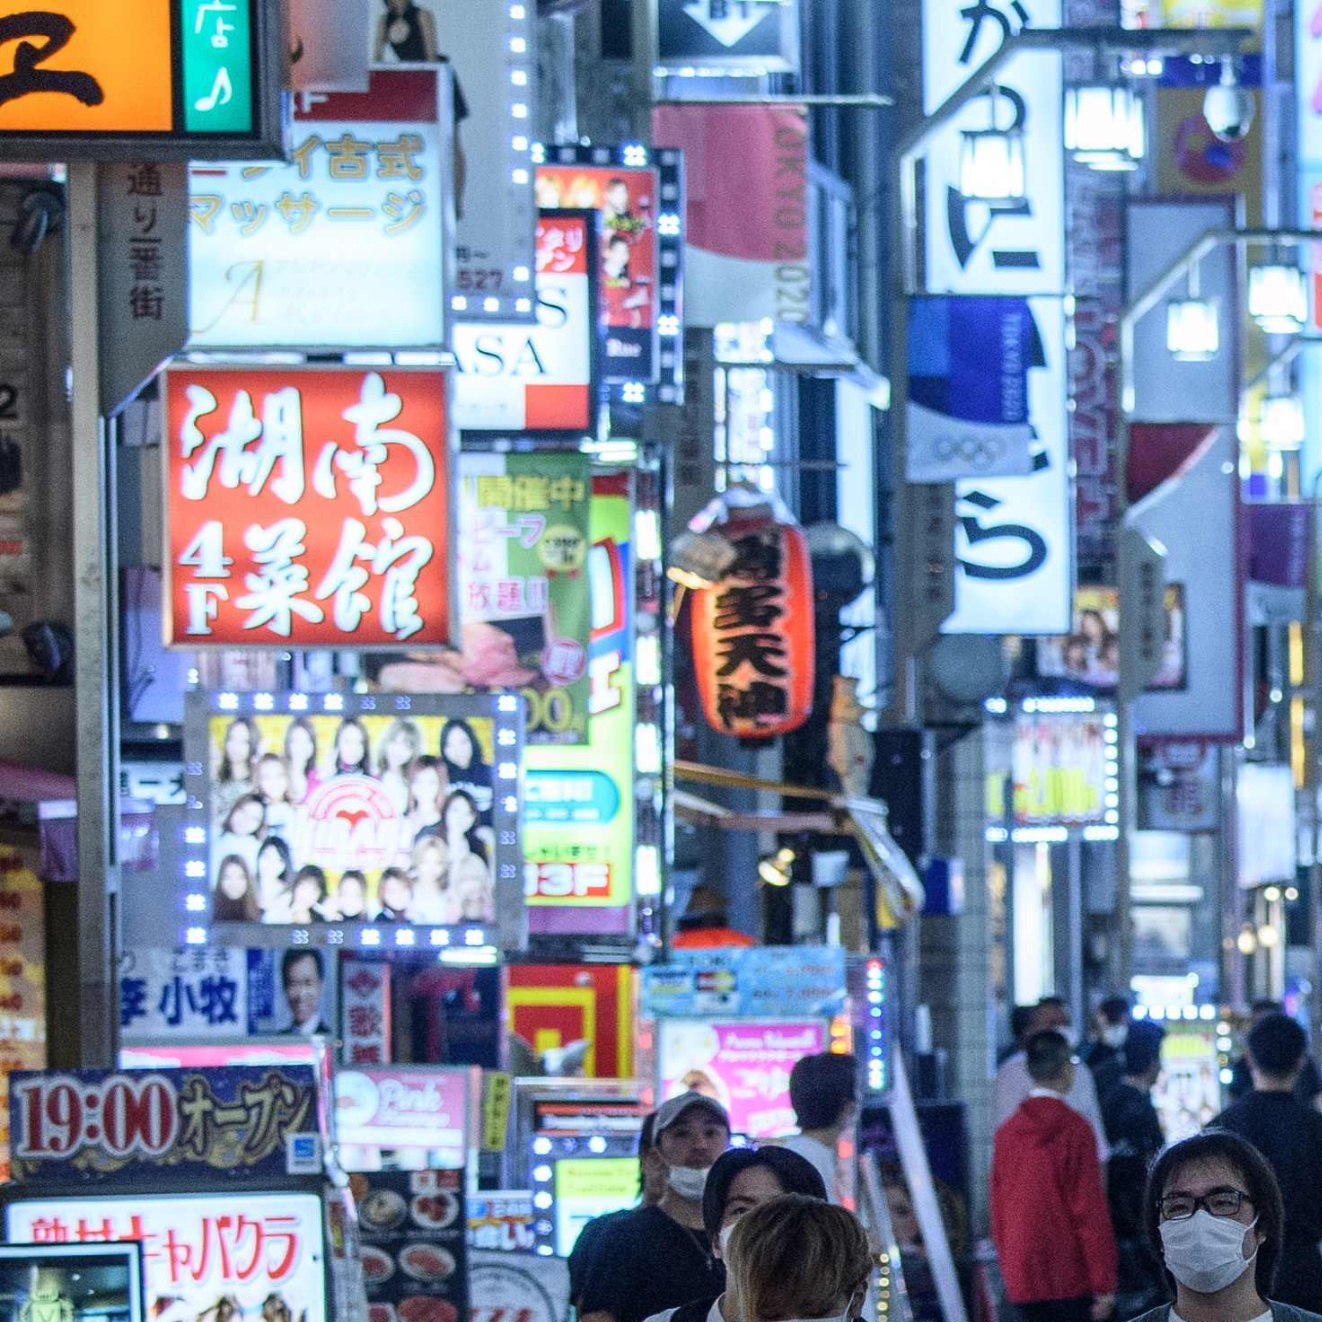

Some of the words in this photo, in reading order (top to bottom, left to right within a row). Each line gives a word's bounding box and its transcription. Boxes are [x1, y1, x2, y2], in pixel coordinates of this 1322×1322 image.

[240, 132, 427, 183] イ古式
[180, 372, 437, 516] 湖南
[236, 516, 434, 639] 菜館
[14, 1077, 178, 1158] 19:00
